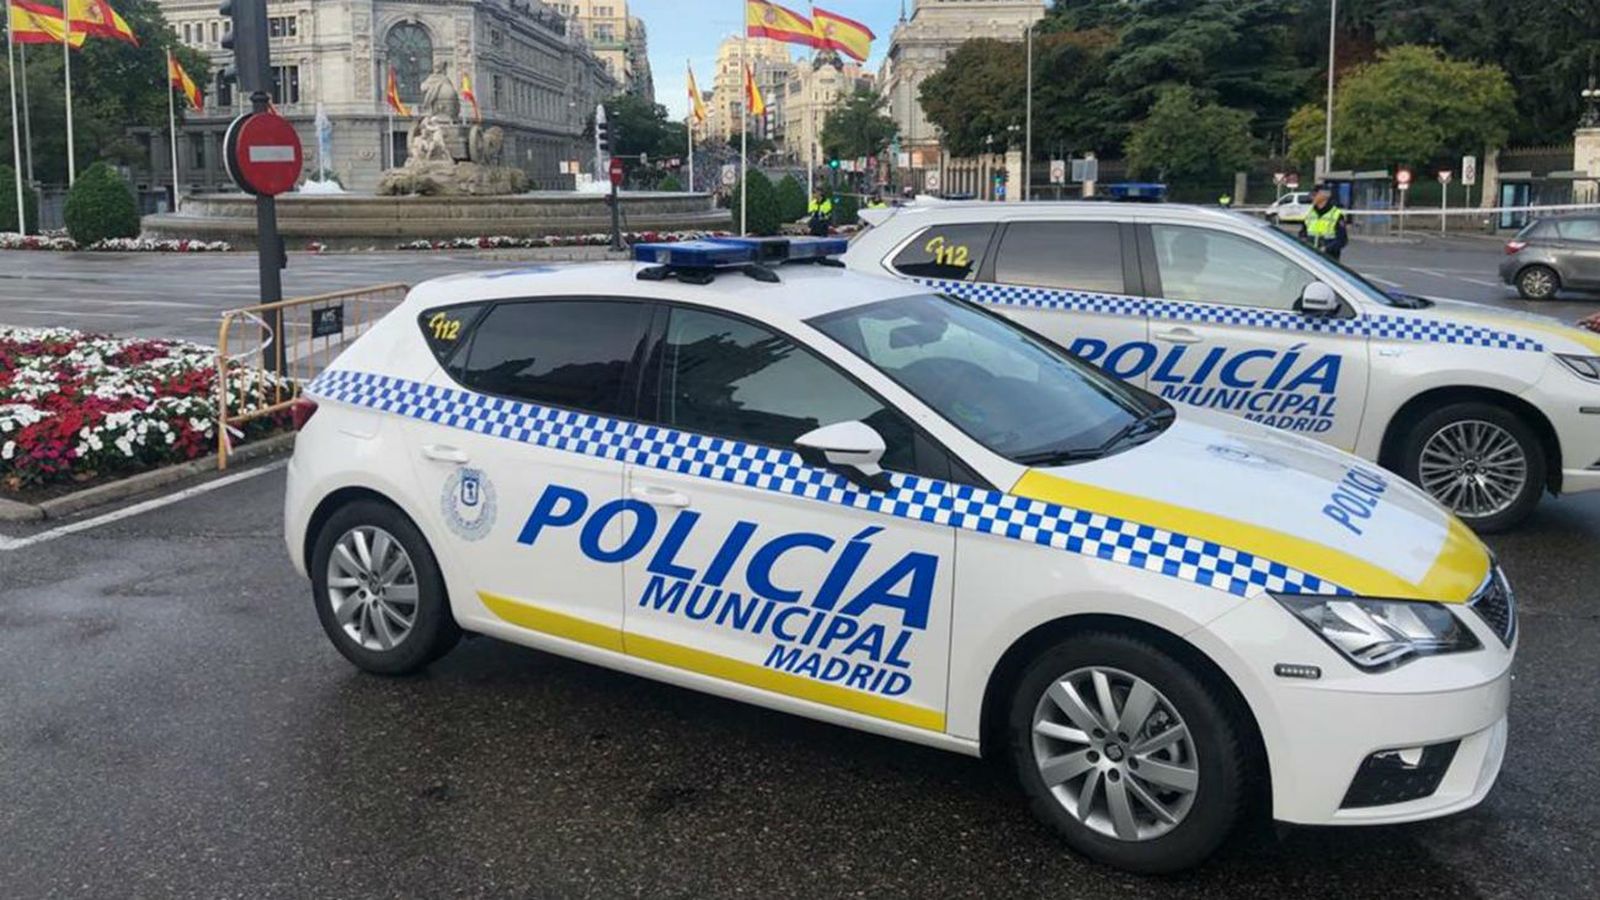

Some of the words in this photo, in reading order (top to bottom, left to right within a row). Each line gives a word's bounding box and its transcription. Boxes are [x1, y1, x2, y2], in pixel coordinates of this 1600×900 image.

[935, 246, 968, 267] 112
[434, 318, 461, 340] 112
[1067, 337, 1342, 394] POLICÍA
[1161, 385, 1337, 418] MUNICIPAL
[516, 484, 939, 630] POLICÍA
[639, 576, 912, 667] MUNICIPAL
[764, 643, 912, 696] MADRID
